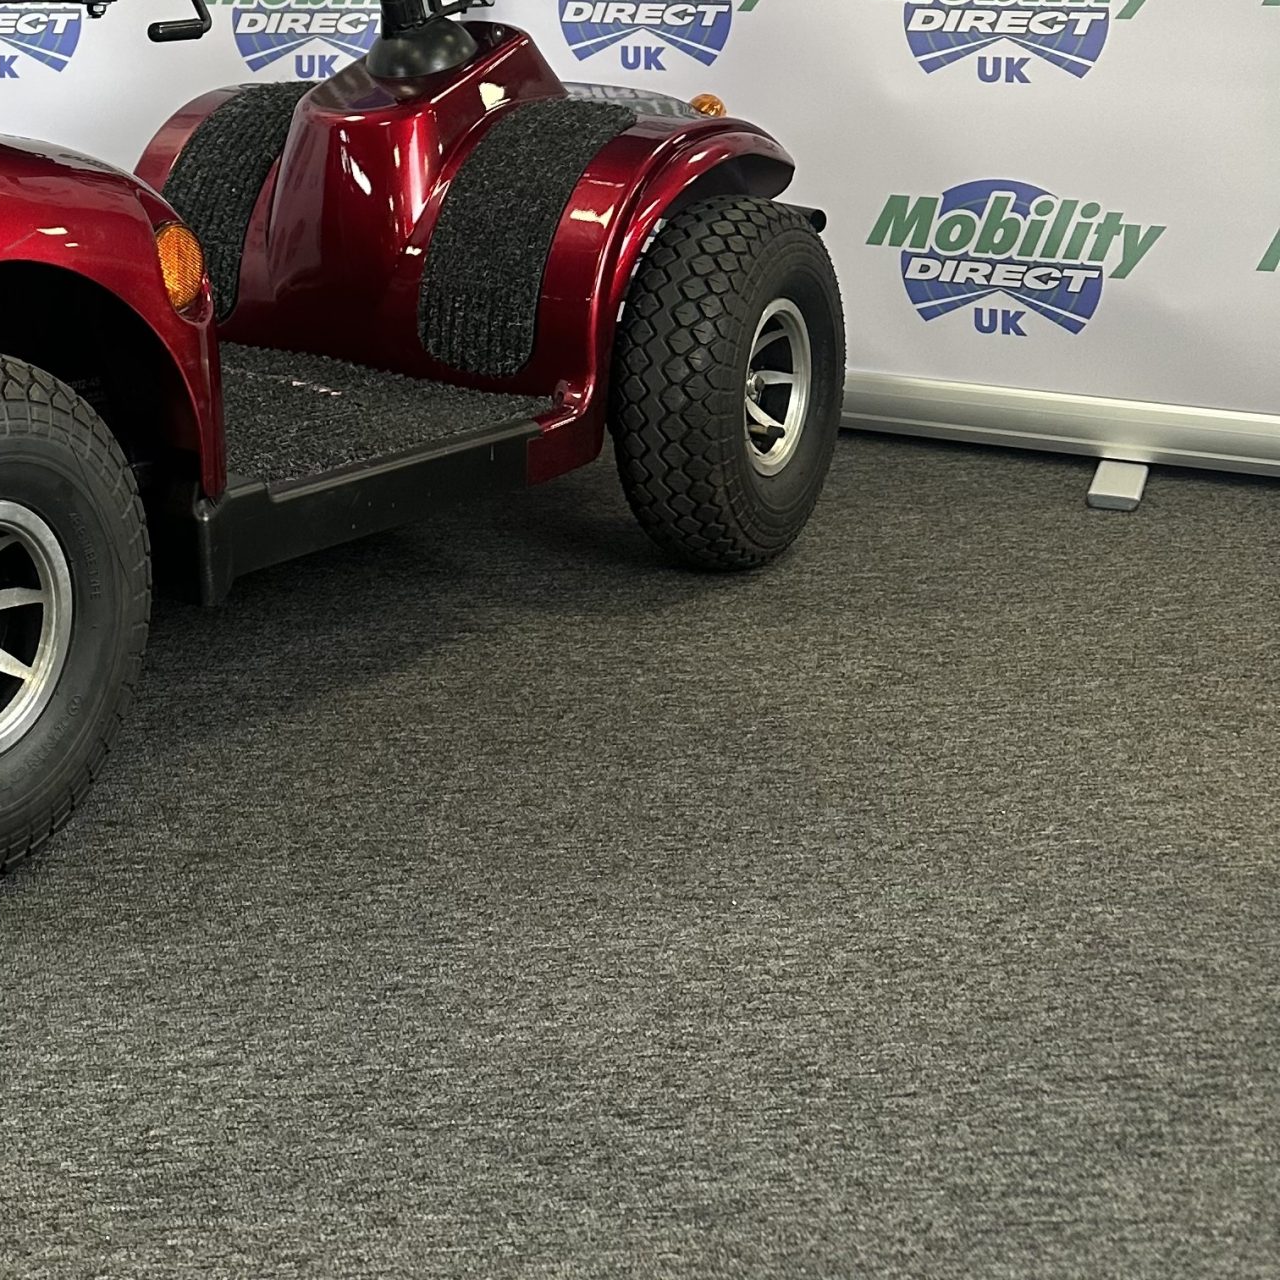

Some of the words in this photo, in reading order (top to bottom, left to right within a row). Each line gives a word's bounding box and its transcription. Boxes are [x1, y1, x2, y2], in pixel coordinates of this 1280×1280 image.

[562, 1, 730, 26] DIRECT
[907, 7, 1107, 37] DIRECT
[295, 54, 340, 78] UK
[620, 45, 666, 71] UK
[977, 57, 1031, 83] UK
[866, 190, 1166, 280] Mobility
[905, 257, 1100, 290] DIRECT
[973, 307, 1027, 337] UK
